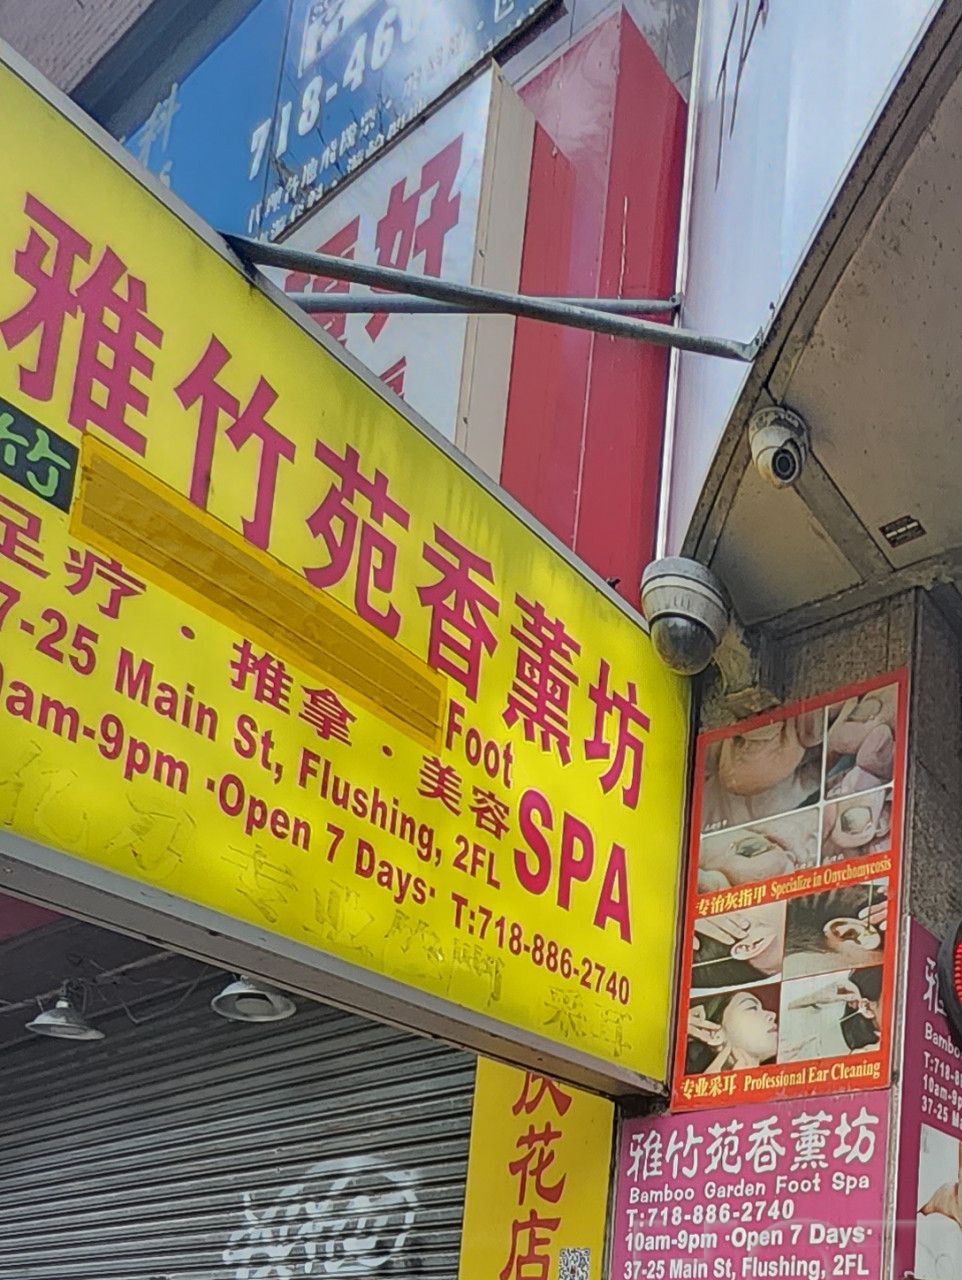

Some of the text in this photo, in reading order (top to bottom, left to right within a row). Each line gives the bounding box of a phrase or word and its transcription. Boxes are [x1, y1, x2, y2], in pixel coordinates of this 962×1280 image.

[230, 639, 512, 841] 推拿 美容
[445, 697, 513, 790] Foot
[115, 646, 502, 890] Main St, Flushing, 2FL
[514, 788, 633, 944] SPA
[696, 884, 768, 917] 专治灰指甲
[770, 872, 813, 901] Specialize
[812, 871, 823, 889] in
[326, 823, 346, 864] 7
[450, 892, 631, 1006] T:718-886-2740
[681, 1073, 737, 1100] 专业采耳
[743, 1057, 881, 1093] Professional Ear Cleaning
[921, 1095, 949, 1123] 37-25
[626, 1106, 880, 1182] 雅竹苑香薰坊
[629, 1171, 870, 1204] Bamboo Garden Foot Spa
[626, 1199, 795, 1228] T:718-886-2740
[624, 1225, 803, 1253] 10am-9pm 7
[623, 1259, 665, 1280] 37-25
[669, 1258, 709, 1280] Main
[713, 1257, 737, 1280] St,
[832, 1254, 870, 1277] 2FL
